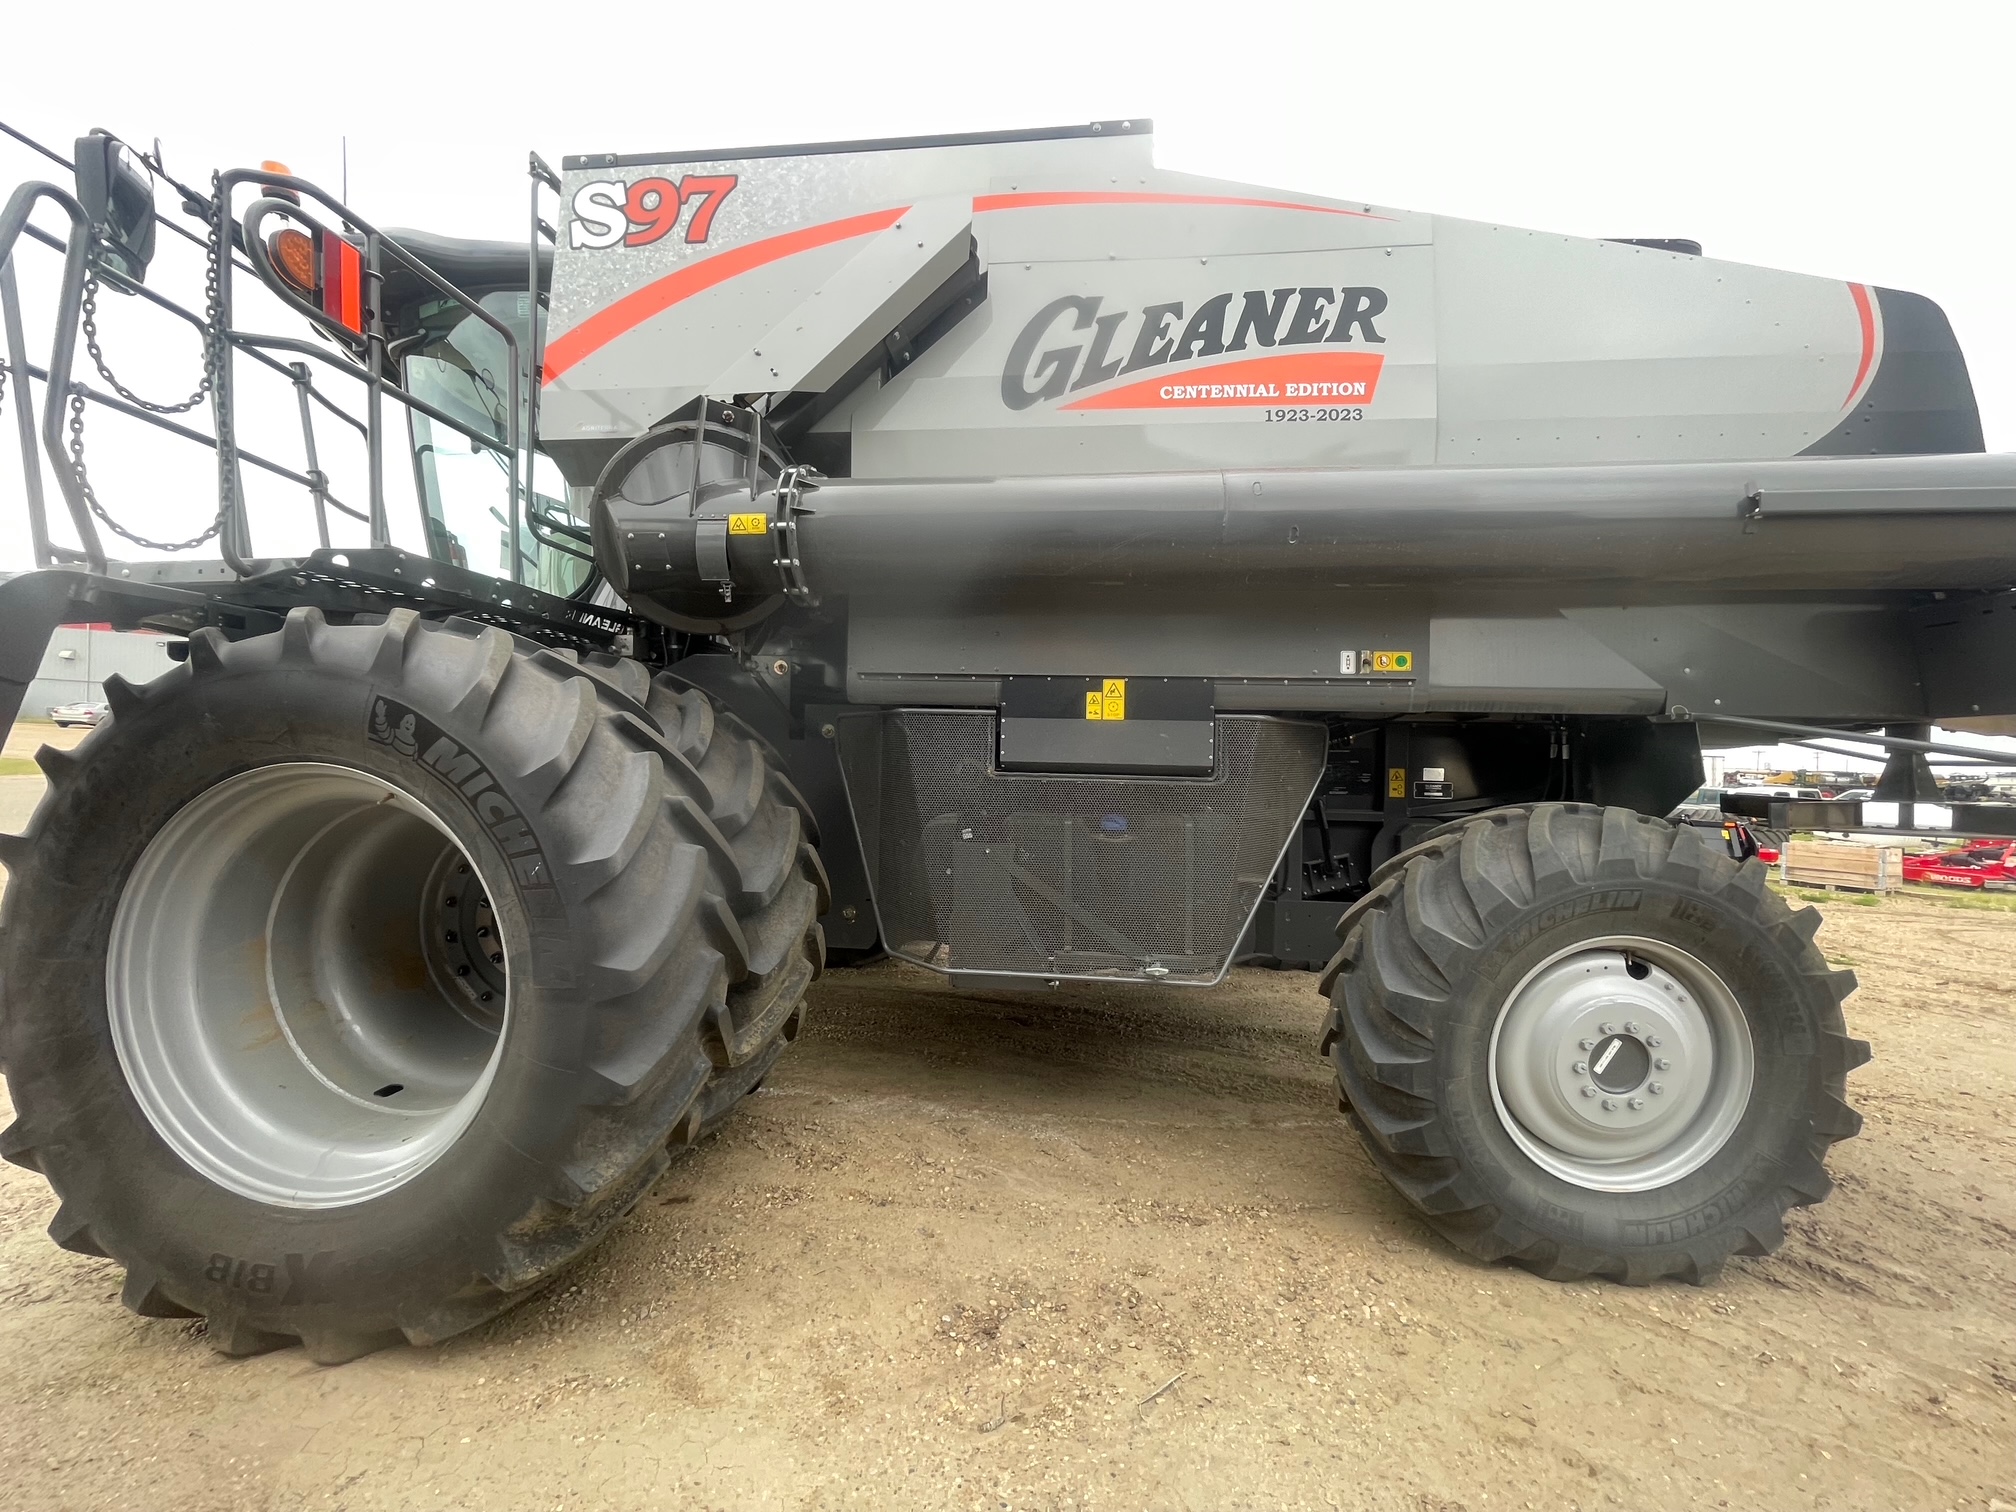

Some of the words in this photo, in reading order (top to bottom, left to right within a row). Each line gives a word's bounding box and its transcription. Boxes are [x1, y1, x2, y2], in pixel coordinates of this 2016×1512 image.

[568, 174, 739, 250] S97
[1000, 286, 1389, 412] GLEANER
[1159, 383, 1280, 400] CENTENNIAL
[1285, 382, 1367, 397] EDITION
[1264, 408, 1364, 423] 1923-2023
